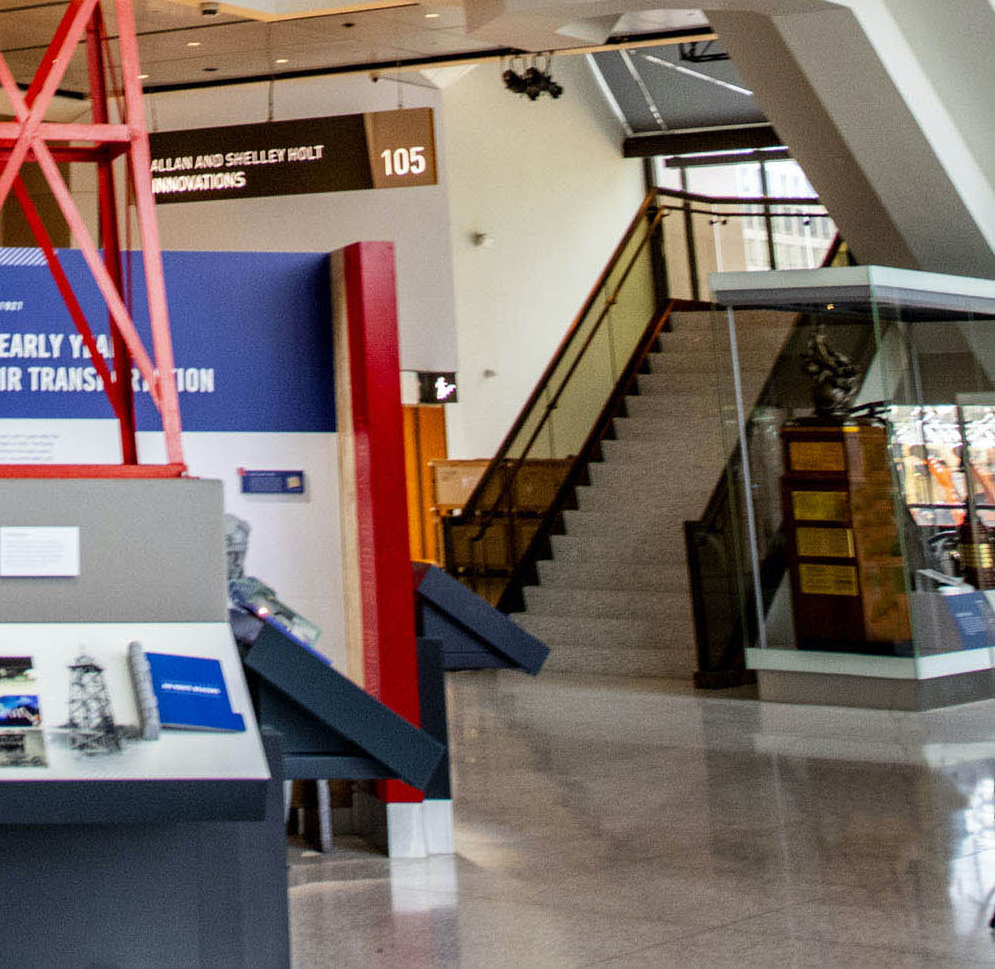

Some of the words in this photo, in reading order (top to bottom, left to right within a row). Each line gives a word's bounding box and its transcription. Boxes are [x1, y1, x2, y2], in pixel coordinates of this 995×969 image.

[150, 157, 193, 173] ALLAN
[195, 154, 224, 170] AND
[225, 149, 286, 168] SHELLEY
[287, 144, 325, 163] HOLT
[380, 146, 426, 176] 105
[151, 171, 246, 194] INNOVATIONS
